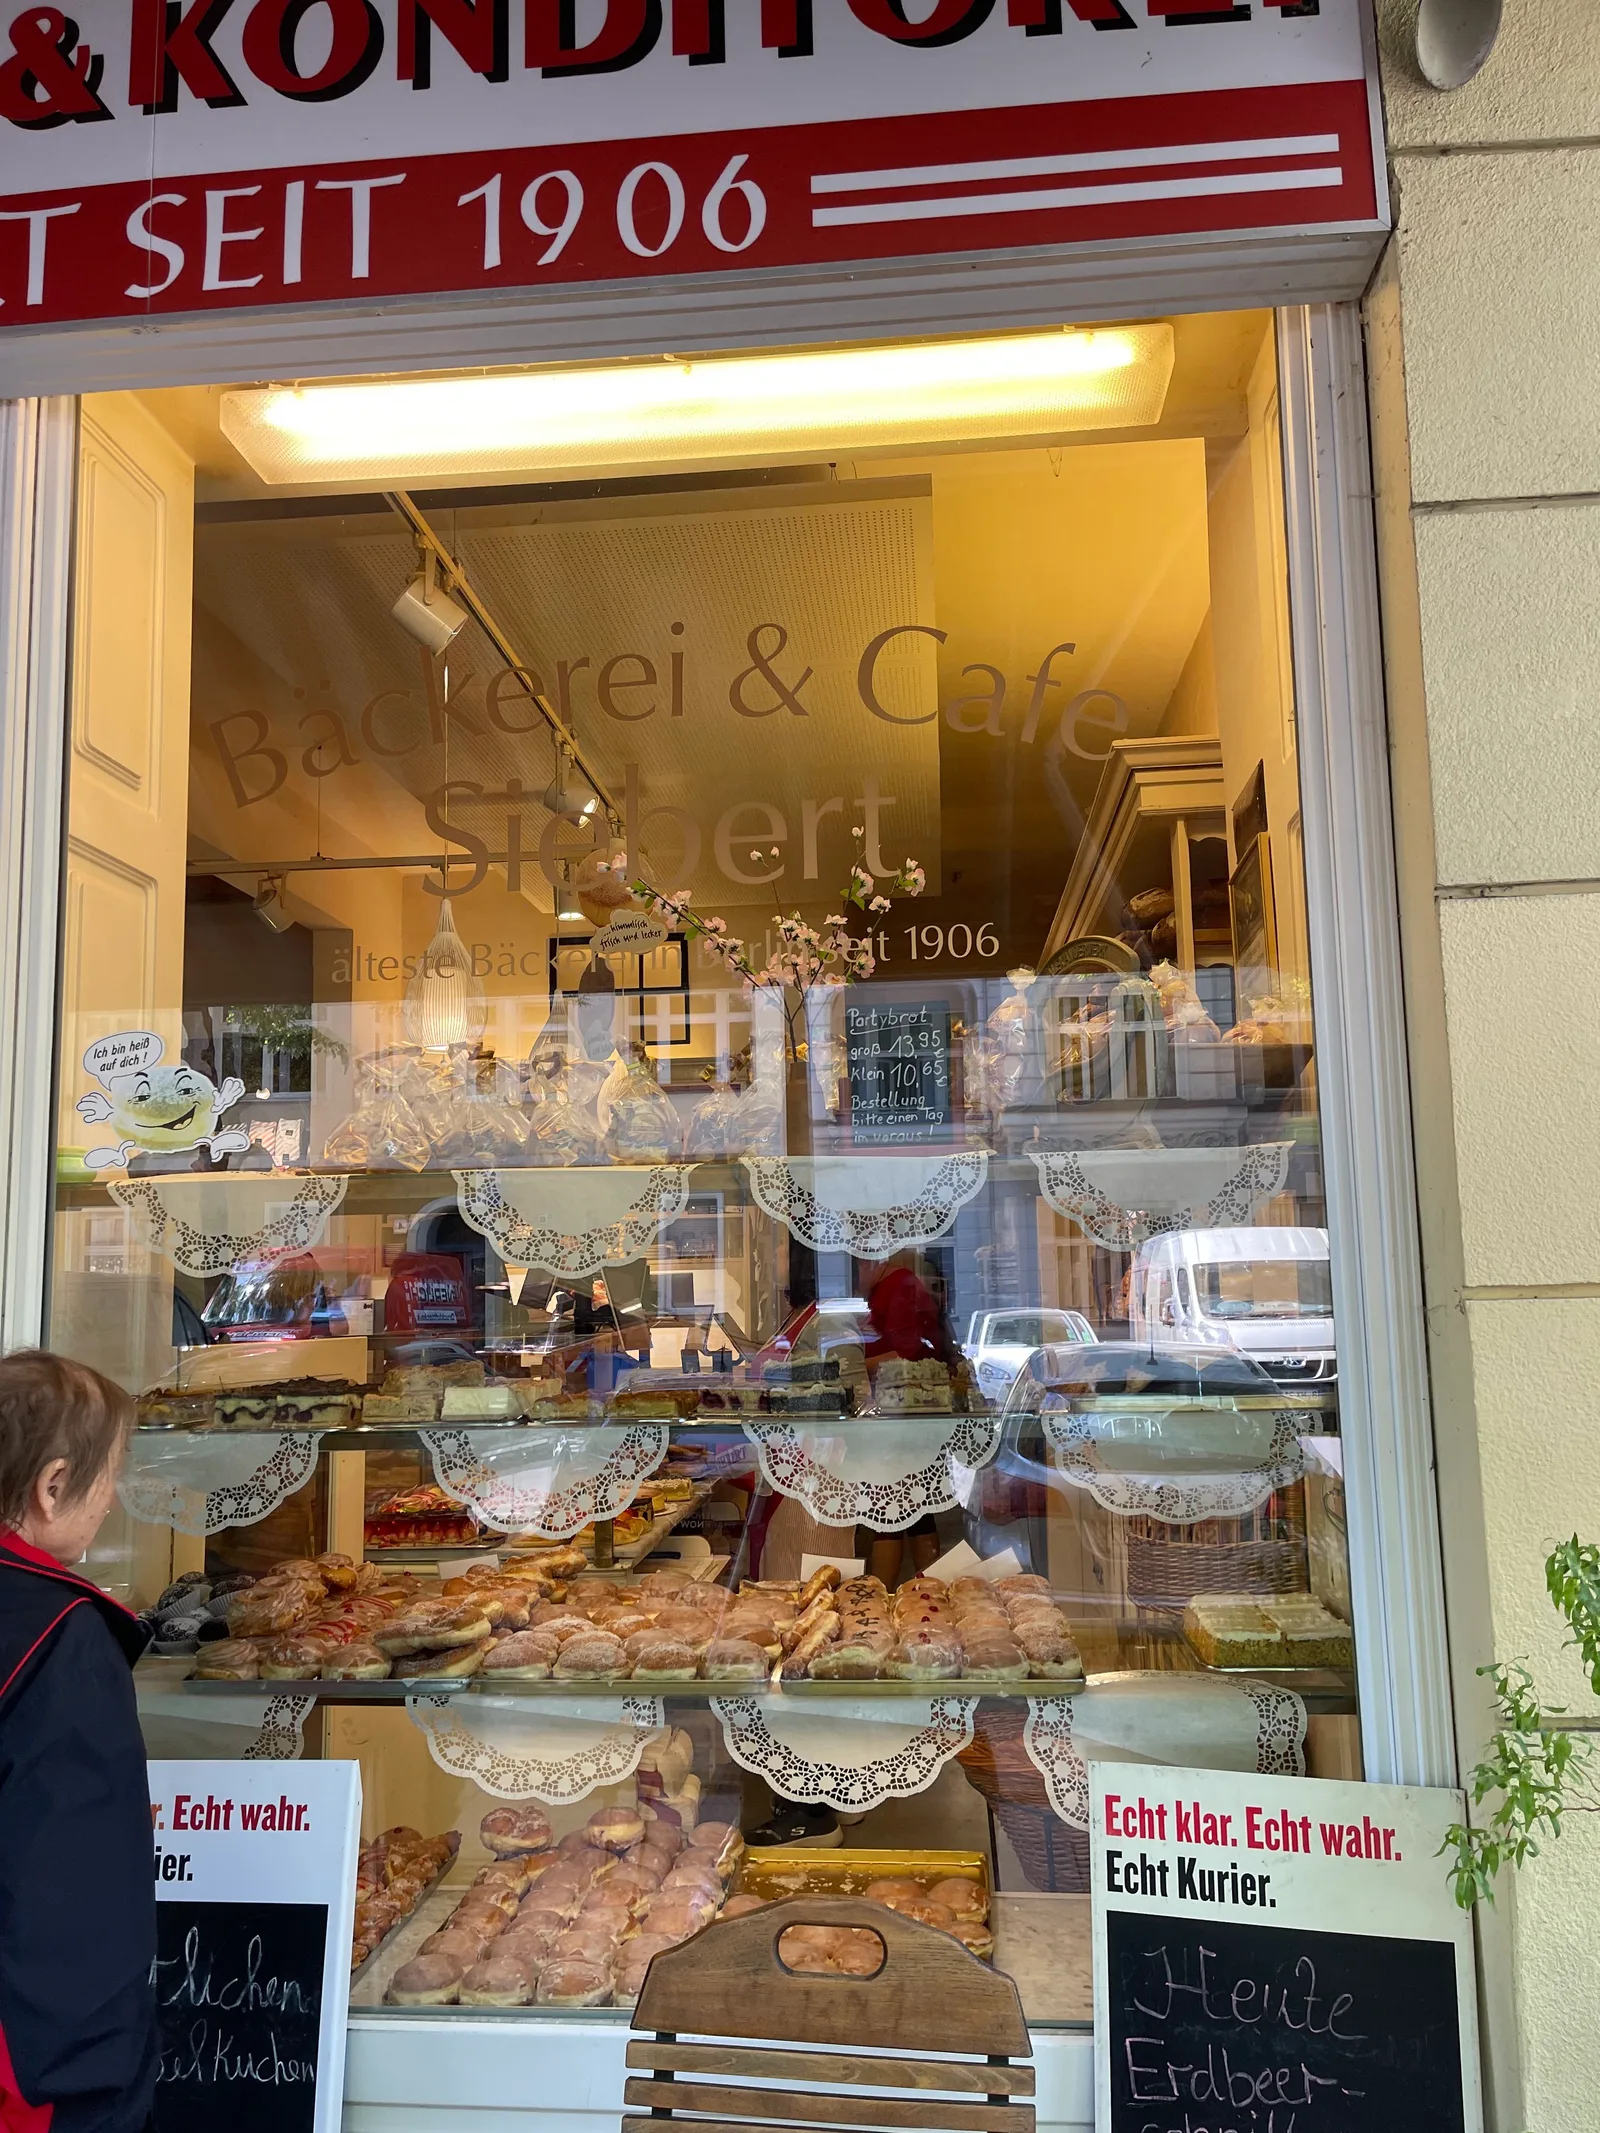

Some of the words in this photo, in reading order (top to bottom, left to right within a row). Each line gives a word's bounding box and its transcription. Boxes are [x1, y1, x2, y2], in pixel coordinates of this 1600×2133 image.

[0, 4, 115, 131] &
[128, 0, 1320, 116] KONDI
[0, 202, 82, 306] T
[125, 173, 407, 298] SEIT
[457, 154, 767, 270] 1906
[210, 621, 685, 809] Bäckerei
[728, 622, 813, 718] &
[857, 625, 1129, 761] Cafe
[422, 763, 902, 898] Siebert
[331, 945, 455, 983] älteste
[822, 926, 891, 964] seit
[903, 922, 1000, 961] 1906
[847, 1005, 928, 1029] Partybrot
[93, 1047, 108, 1059] Ich
[111, 1043, 126, 1055] bin
[130, 1037, 150, 1051] heiß
[100, 1058, 117, 1072] auf
[119, 1054, 139, 1068] dich
[850, 1043, 881, 1061] groß
[851, 1090, 926, 1110] Bestellung
[852, 1113, 883, 1127] bitte
[886, 1112, 918, 1125] einen
[922, 1106, 944, 1125] Tag
[172, 1795, 234, 1830] Echt
[240, 1795, 311, 1831] wahr.
[1105, 1794, 1168, 1841] Echt
[1176, 1800, 1238, 1847] klar.
[1245, 1806, 1311, 1854] Echt
[1319, 1816, 1402, 1862] wahr.
[154, 1845, 193, 1882] ier.
[1106, 1850, 1169, 1898] Echt
[1177, 1856, 1277, 1907] Kurier.
[1134, 1944, 1368, 2040] Heute
